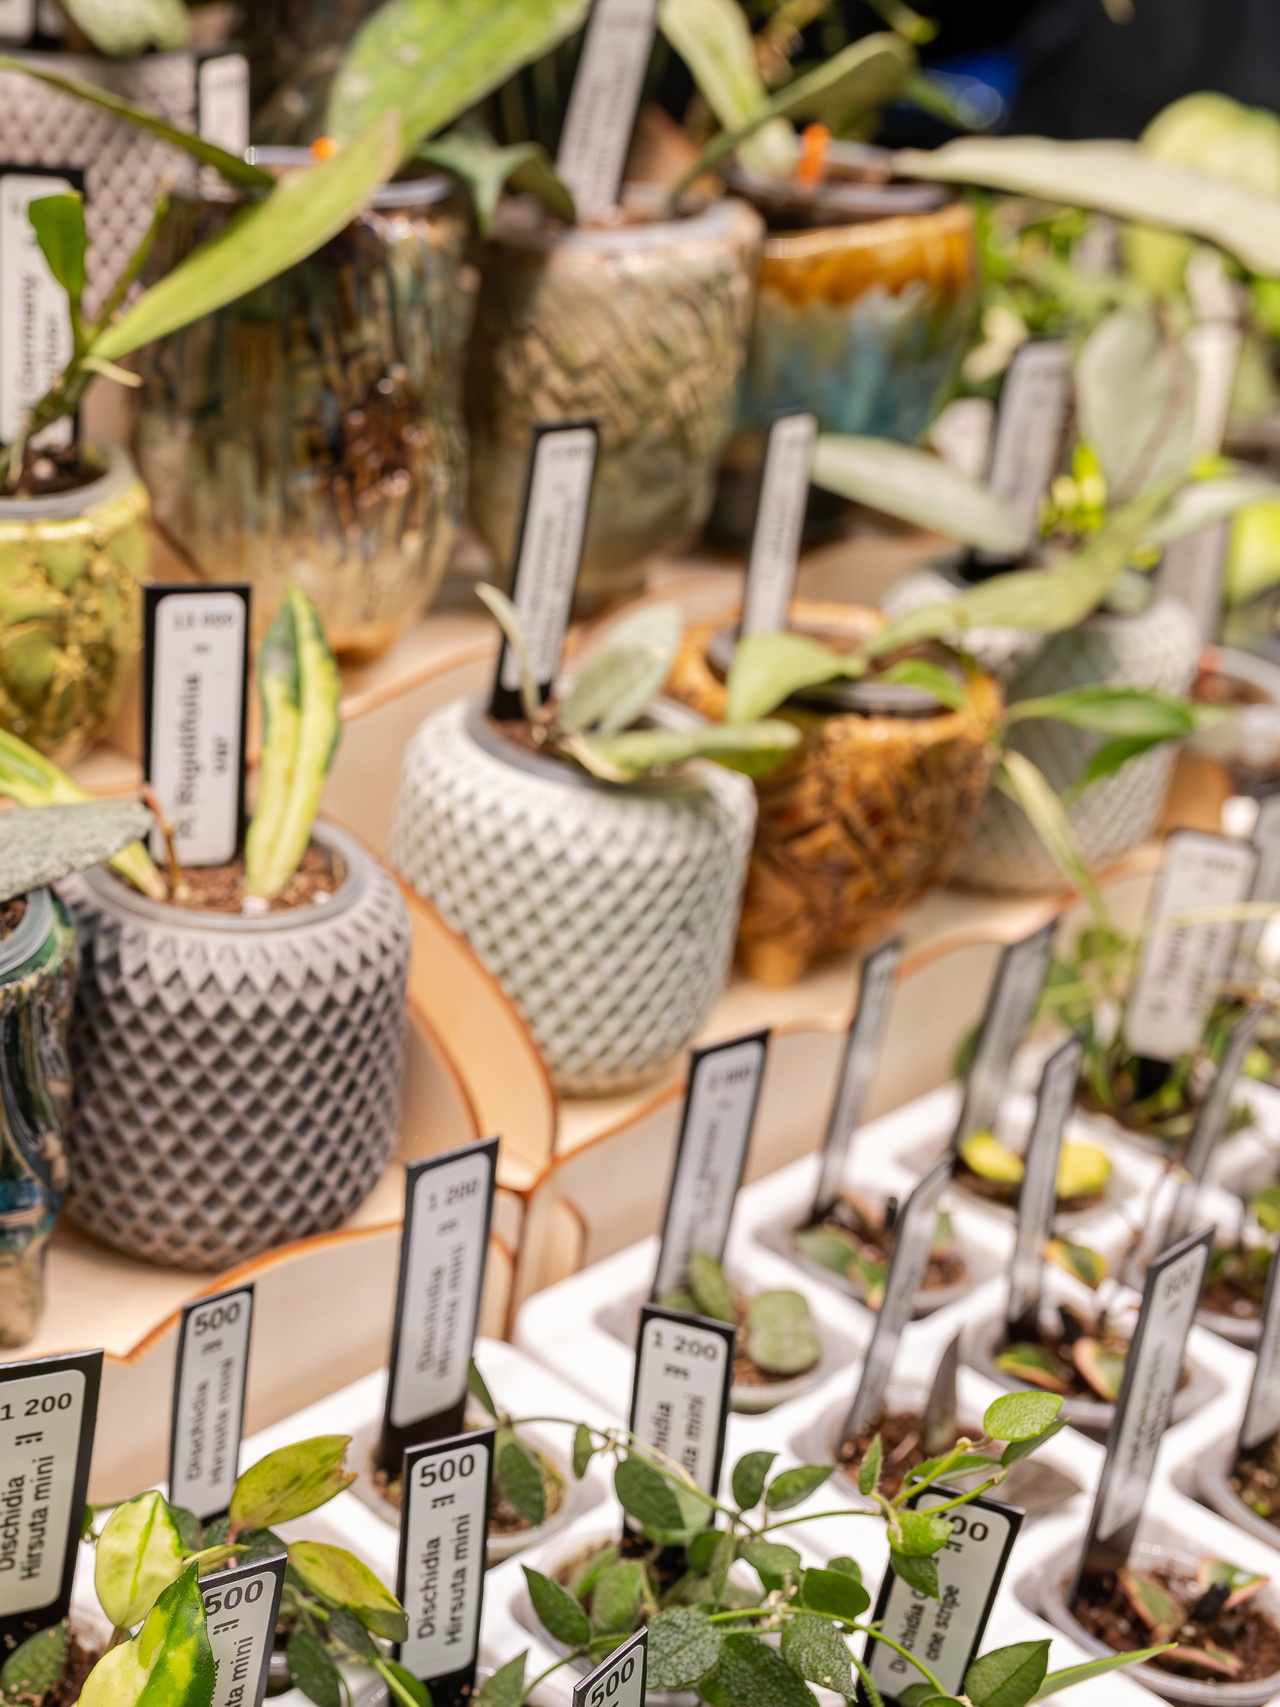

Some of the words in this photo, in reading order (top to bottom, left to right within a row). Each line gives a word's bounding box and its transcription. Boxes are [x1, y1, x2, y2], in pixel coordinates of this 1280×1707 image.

[194, 1301, 241, 1336] 500
[652, 1331, 663, 1348] 1
[672, 1335, 719, 1361] 200
[0, 1404, 14, 1421] 1
[24, 1392, 73, 1417] 200
[30, 1455, 55, 1501] mini
[419, 1454, 475, 1488] 500
[19, 1505, 49, 1581] Hirsuta
[451, 1513, 472, 1563] mini
[937, 1512, 989, 1542] 00
[204, 1580, 264, 1616] 500
[417, 1535, 441, 1640] Dischidia
[444, 1566, 467, 1647] Hirsuta
[933, 1584, 960, 1631] stripe
[231, 1636, 253, 1682] mini
[591, 1657, 635, 1707] 500
